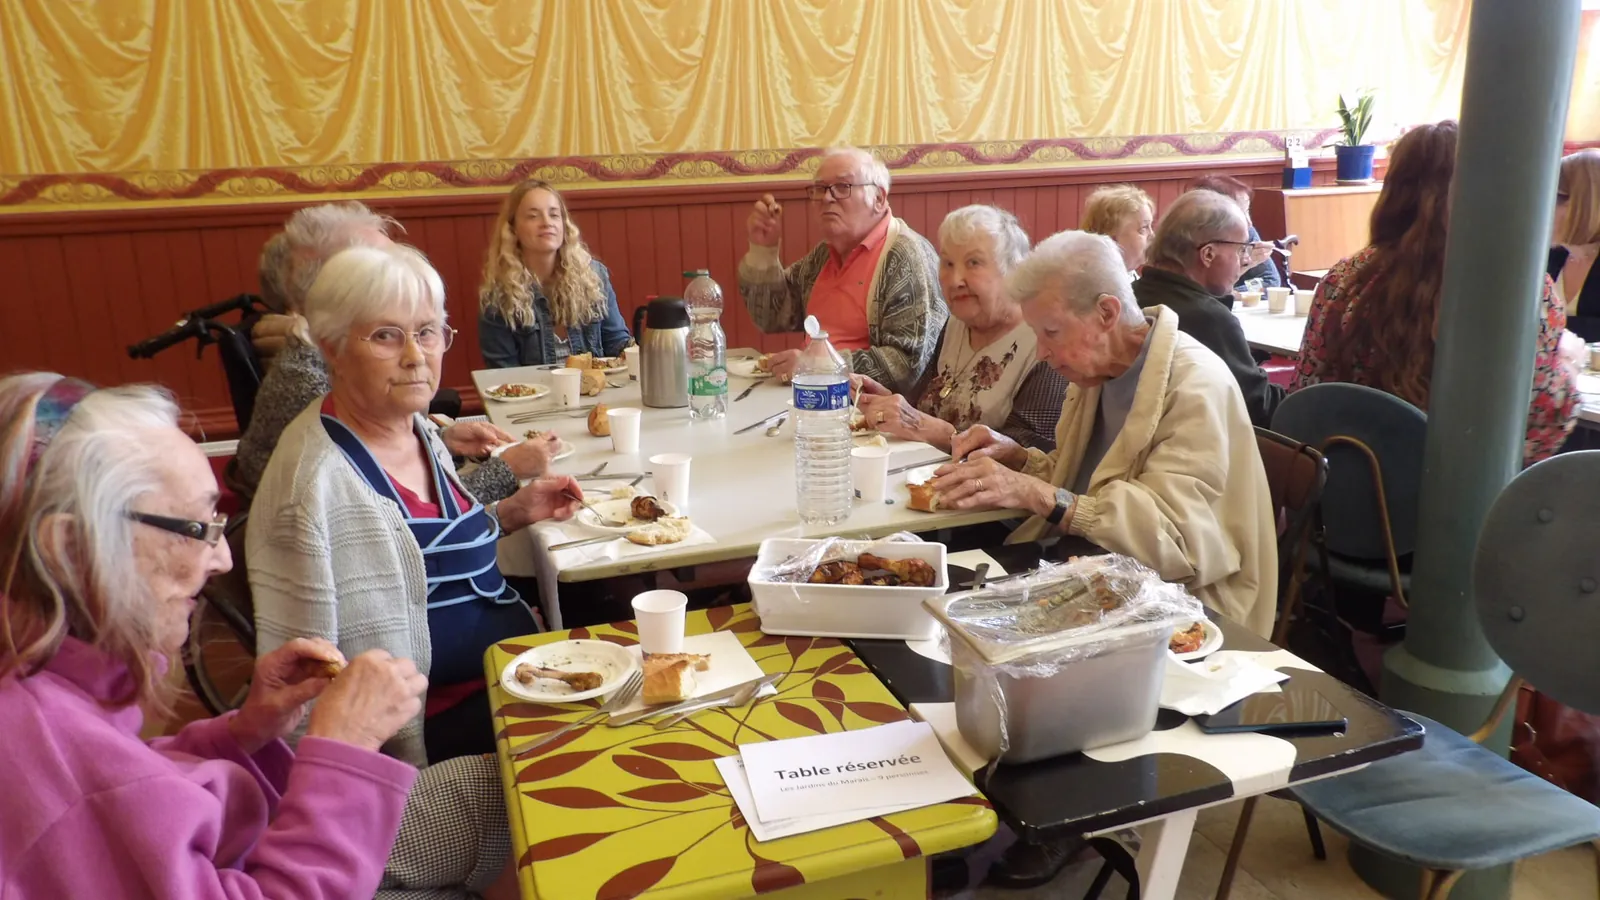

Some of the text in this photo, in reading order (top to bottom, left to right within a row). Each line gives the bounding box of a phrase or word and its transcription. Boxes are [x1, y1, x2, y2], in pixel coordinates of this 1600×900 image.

[774, 754, 922, 780] Table réservée
[796, 782, 826, 791] Jardins
[840, 776, 870, 785] Marais
